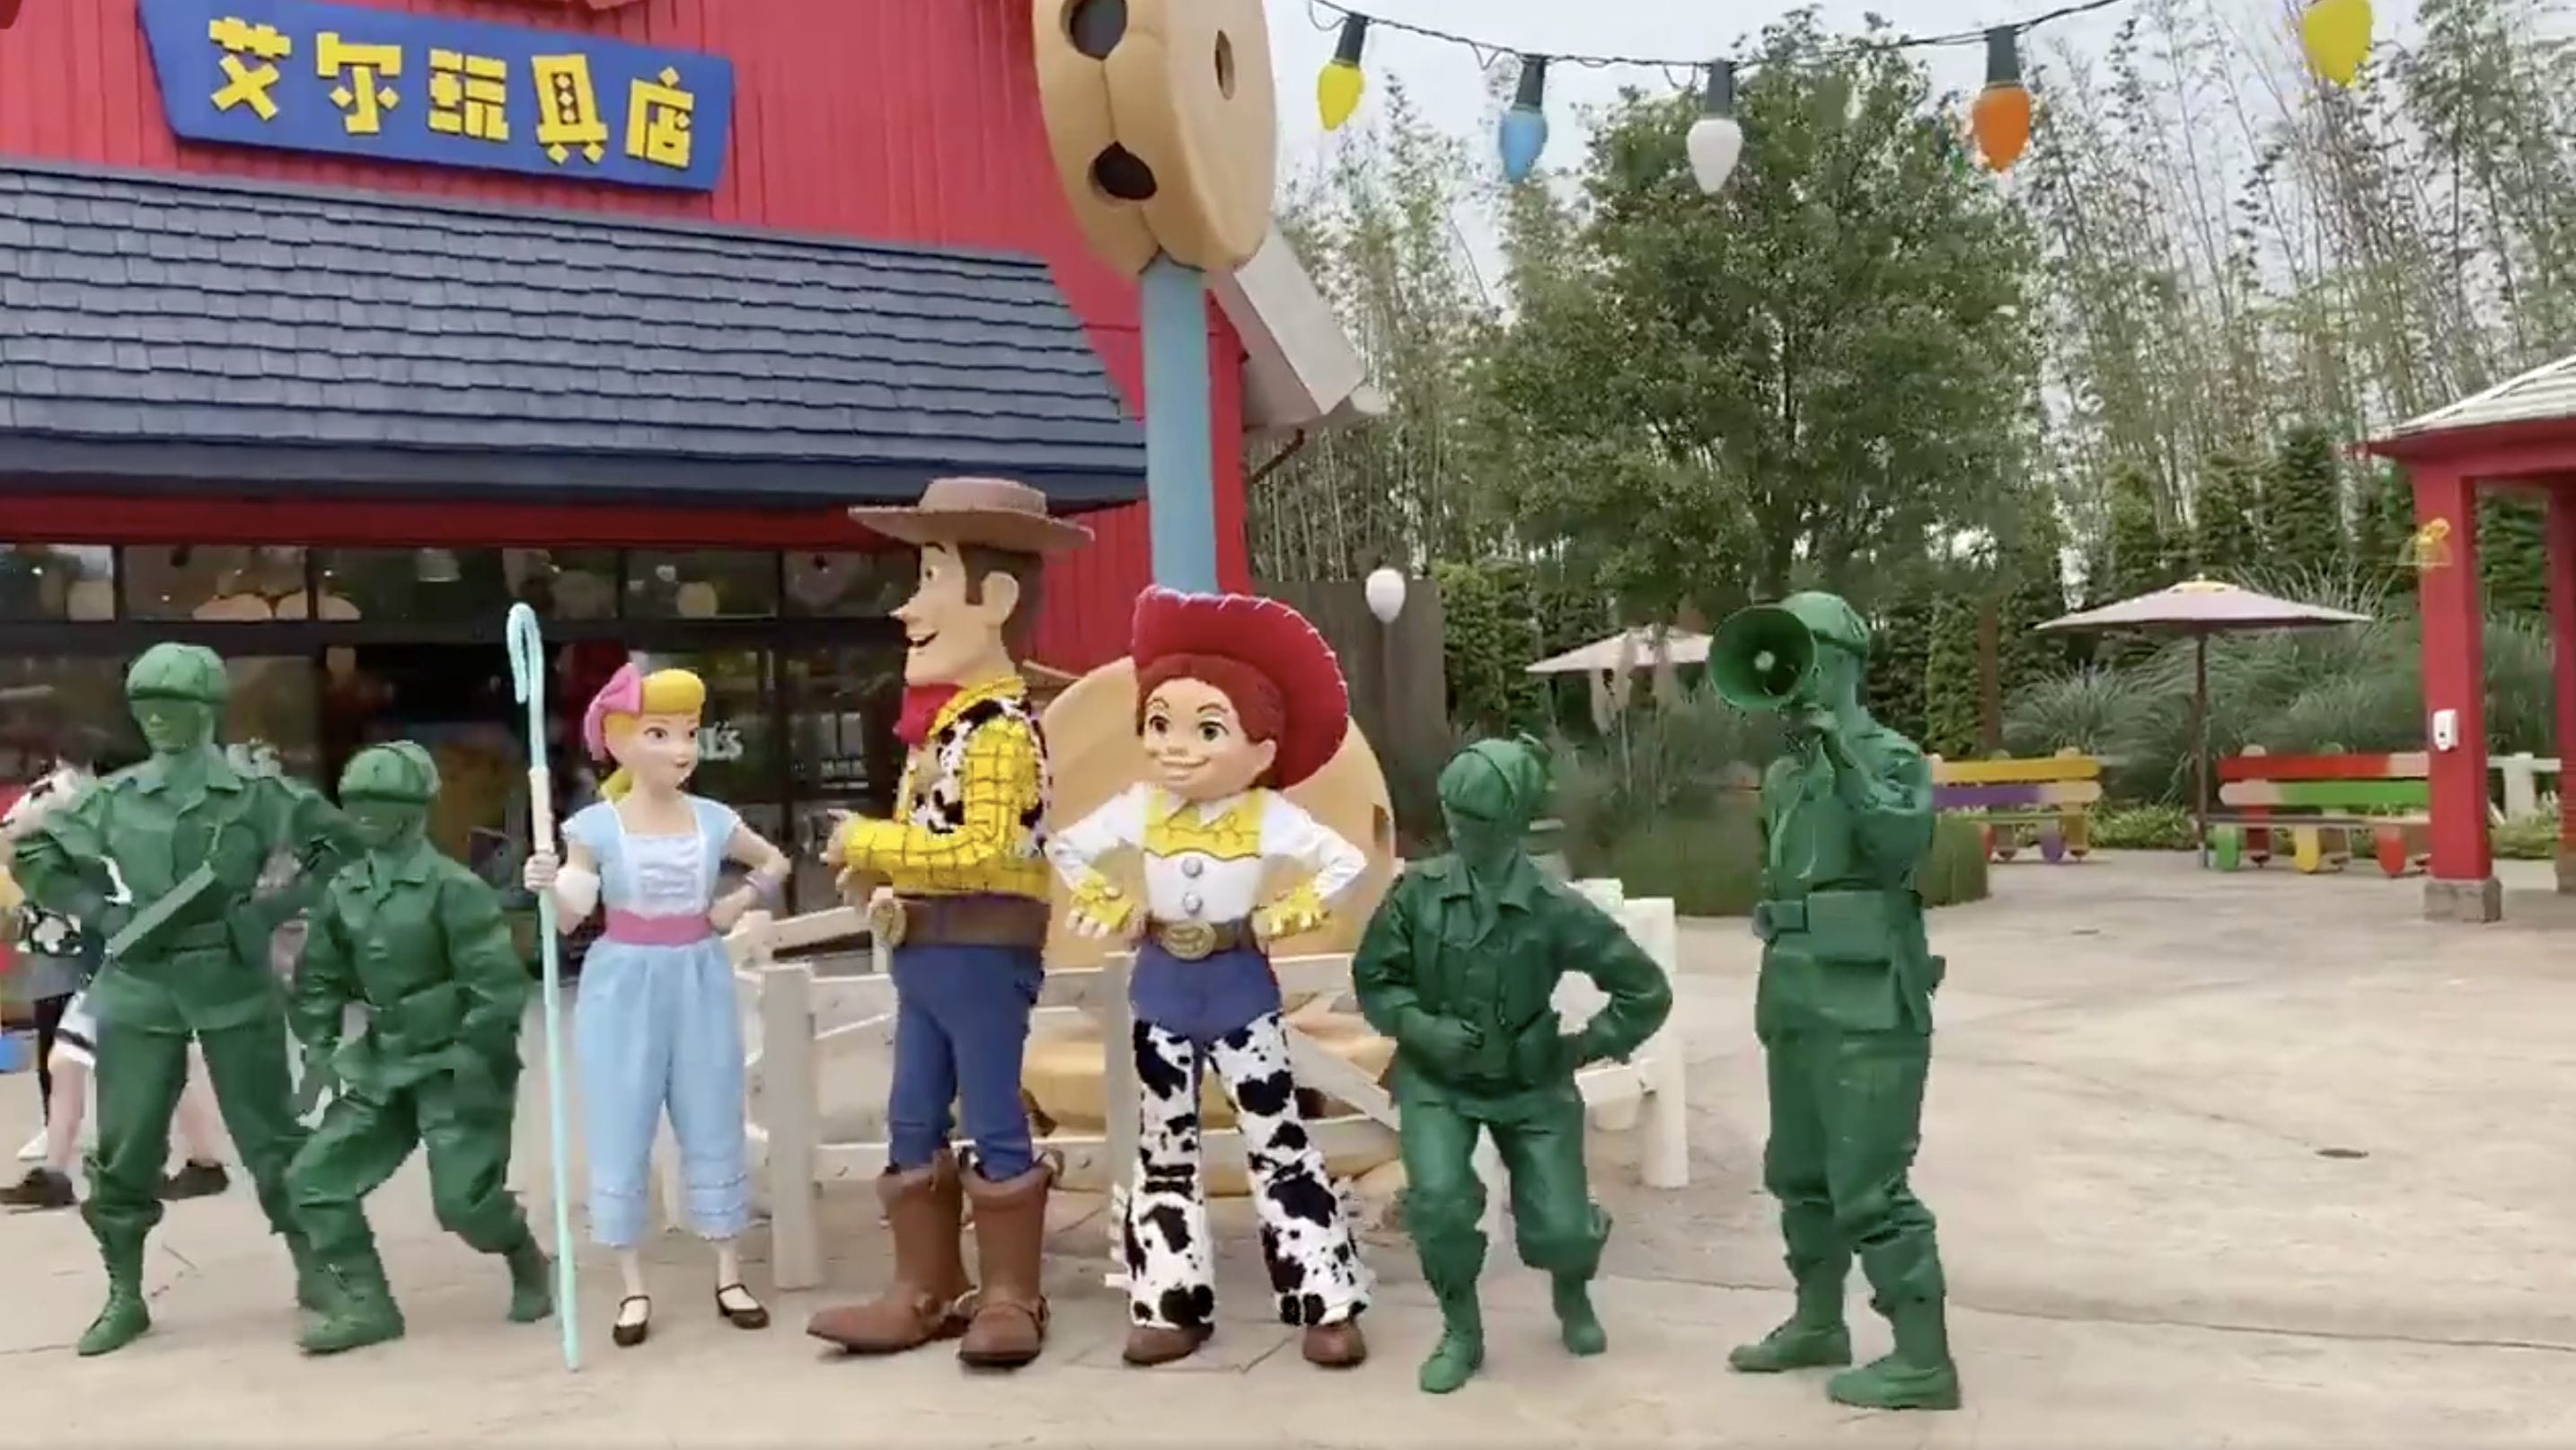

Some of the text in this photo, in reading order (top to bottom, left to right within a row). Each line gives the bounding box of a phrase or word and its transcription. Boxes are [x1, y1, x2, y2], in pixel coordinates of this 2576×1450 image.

[208, 16, 695, 168] 艾尔玩具店
